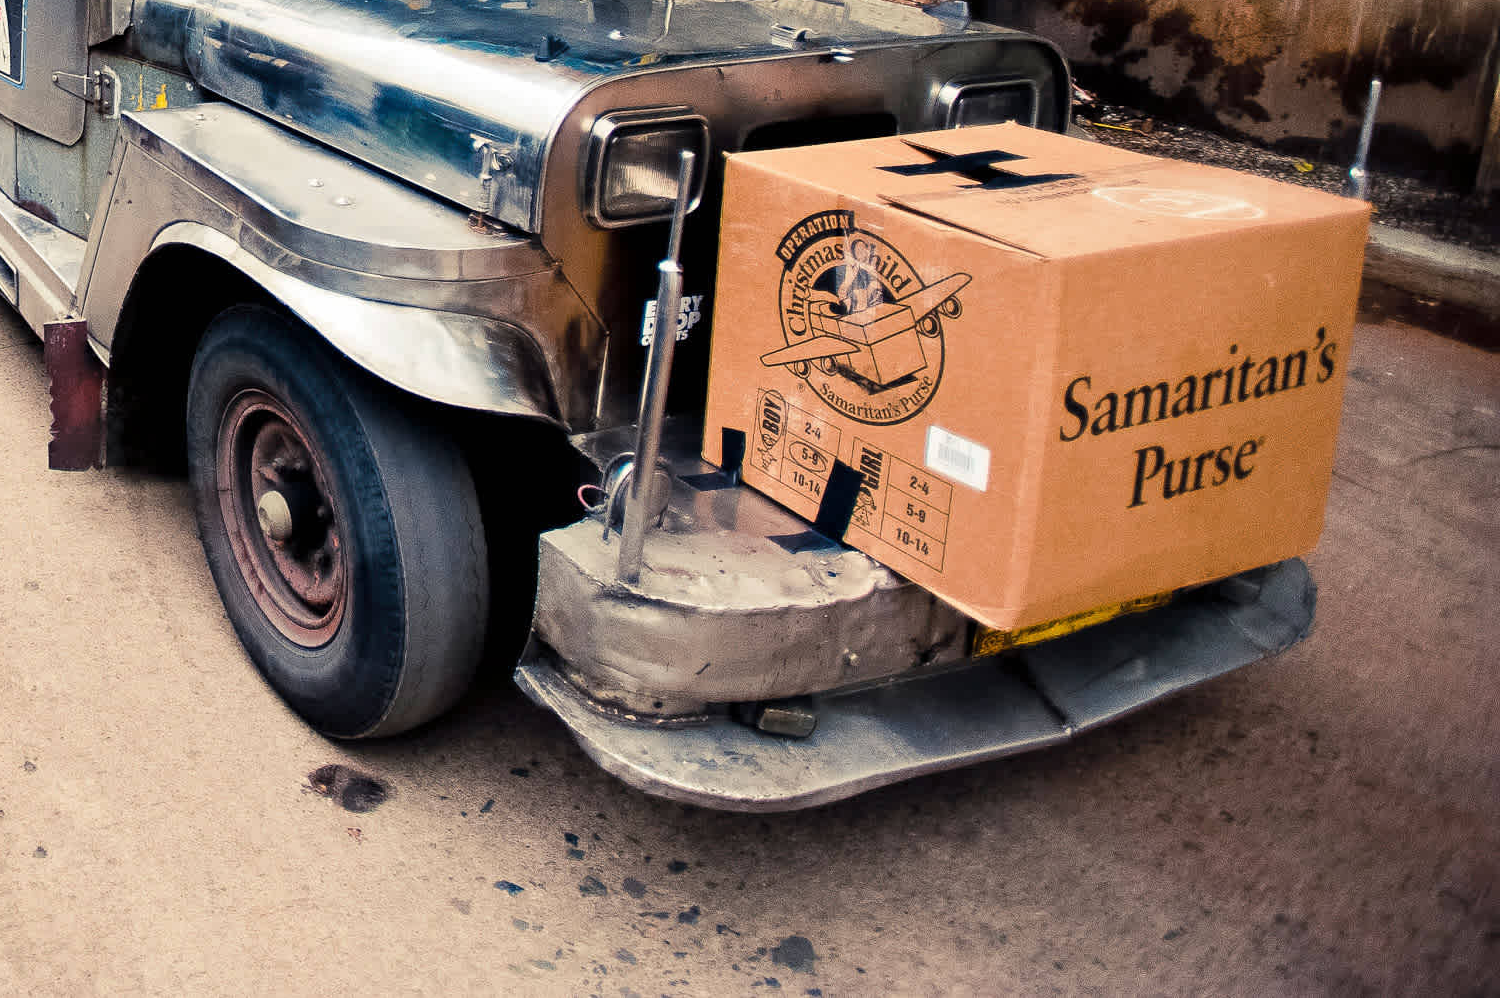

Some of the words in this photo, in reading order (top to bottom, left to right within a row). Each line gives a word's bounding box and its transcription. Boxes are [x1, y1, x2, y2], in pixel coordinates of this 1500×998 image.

[780, 213, 851, 261] OPERATION
[787, 242, 846, 337] Christmas
[850, 238, 913, 293] Child
[819, 382, 901, 420] Samaritan's
[900, 375, 934, 413] Purse
[1059, 327, 1337, 442] Samaritan's
[762, 398, 782, 436] BOY
[804, 421, 822, 440] 2-4
[801, 447, 819, 466] 5-9
[859, 446, 884, 490] GIRL
[1125, 439, 1258, 509] Purse
[793, 471, 821, 497] 10-14
[909, 475, 930, 496] 2-4
[906, 503, 927, 523] 5-9
[895, 528, 929, 555] 10-14
